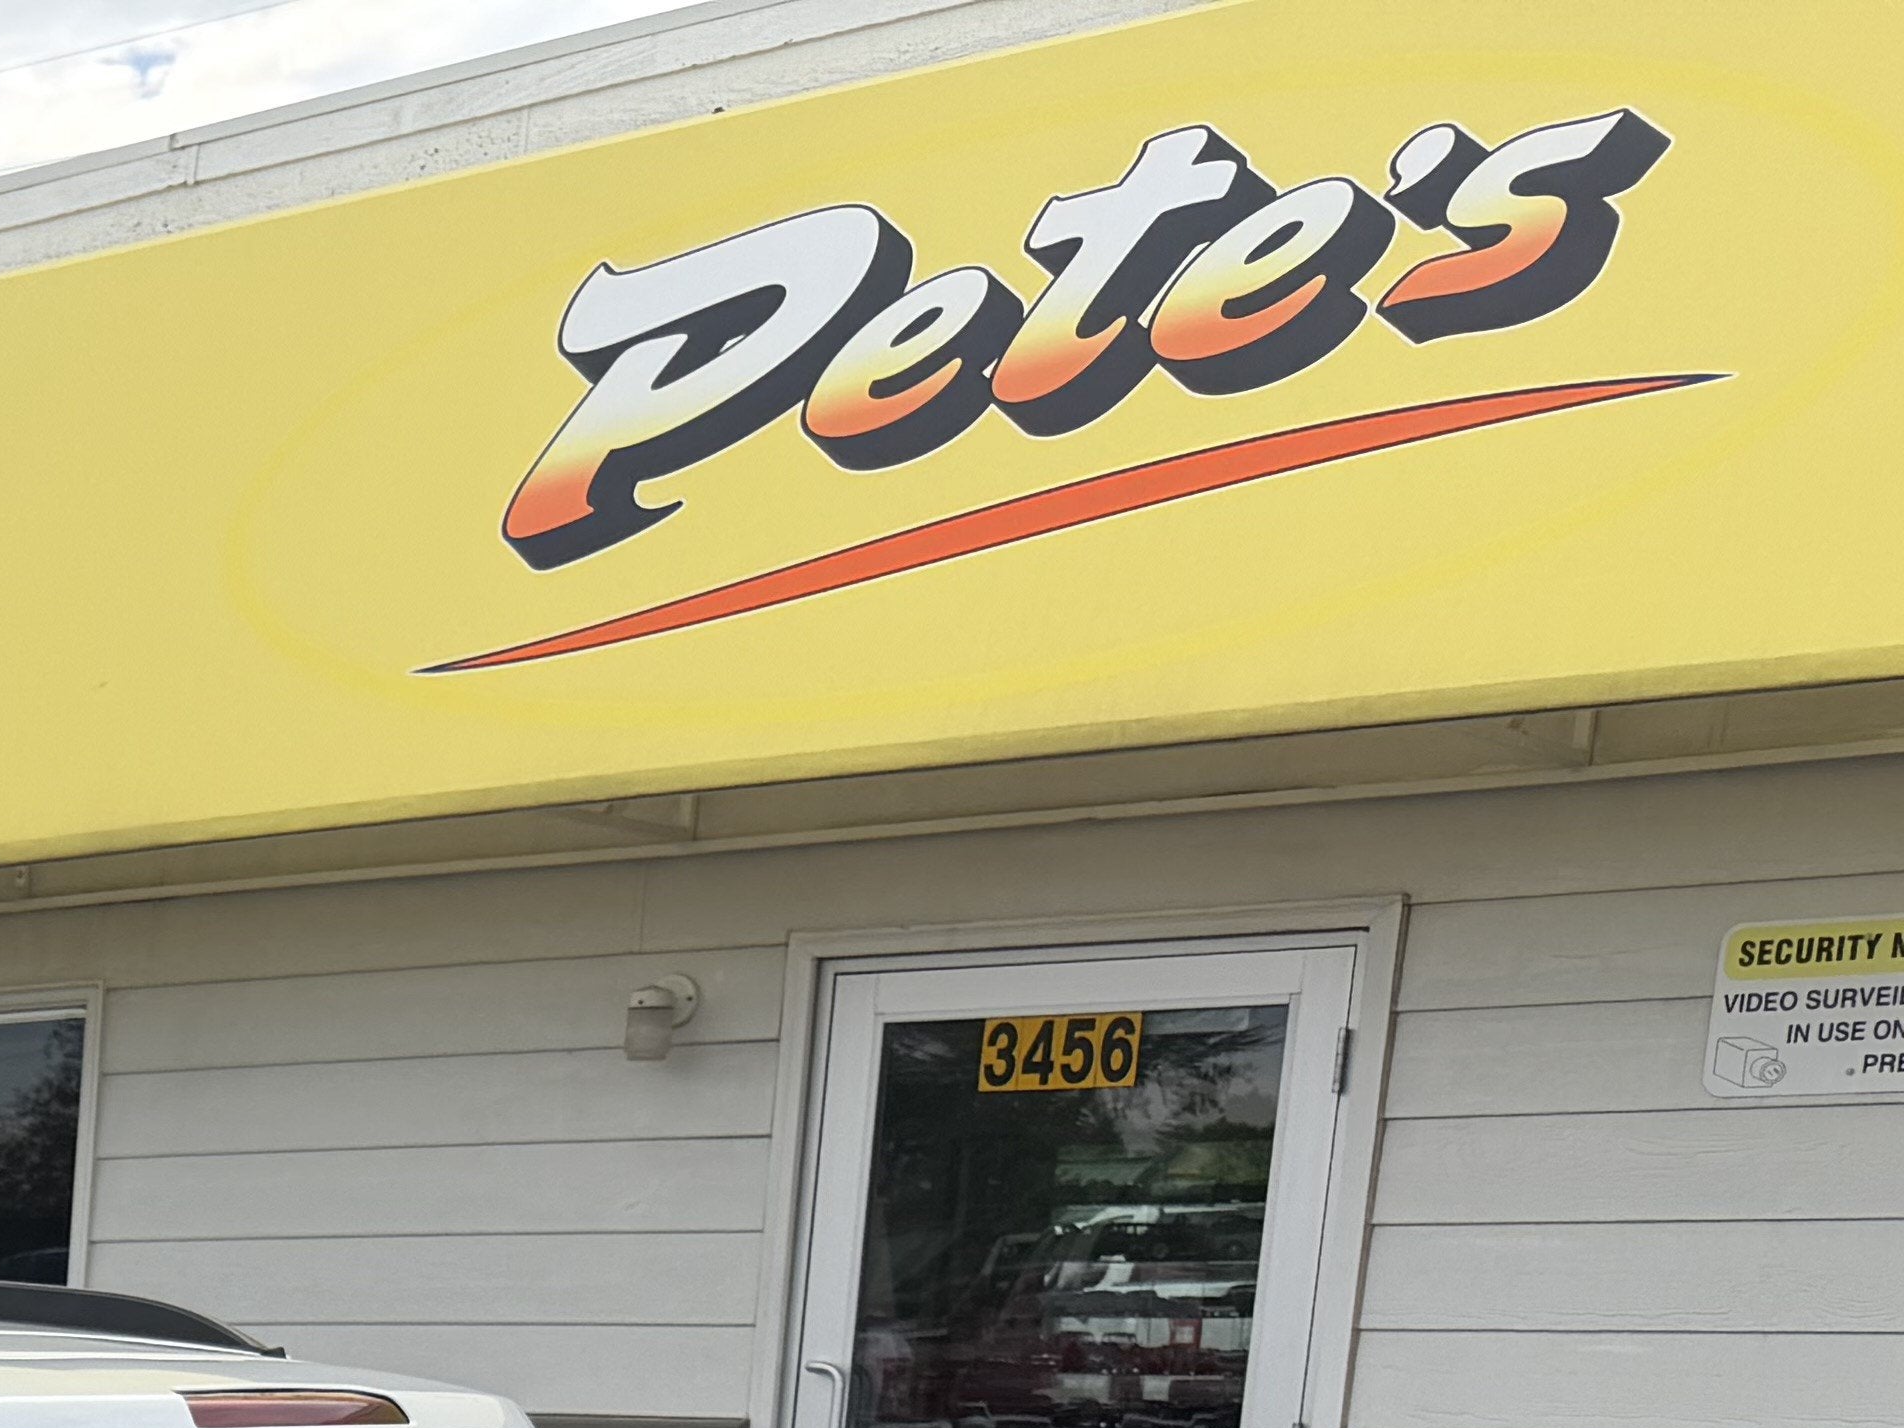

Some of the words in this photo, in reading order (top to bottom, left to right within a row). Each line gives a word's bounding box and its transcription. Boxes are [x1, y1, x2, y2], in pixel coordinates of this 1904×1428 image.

[500, 107, 1673, 571] Pete's
[1738, 932, 1883, 967] SECURITY
[1723, 991, 1798, 1014] VIDEO
[1786, 1022, 1810, 1044] IN
[1818, 1020, 1866, 1042] USE
[983, 1016, 1136, 1087] 3456
